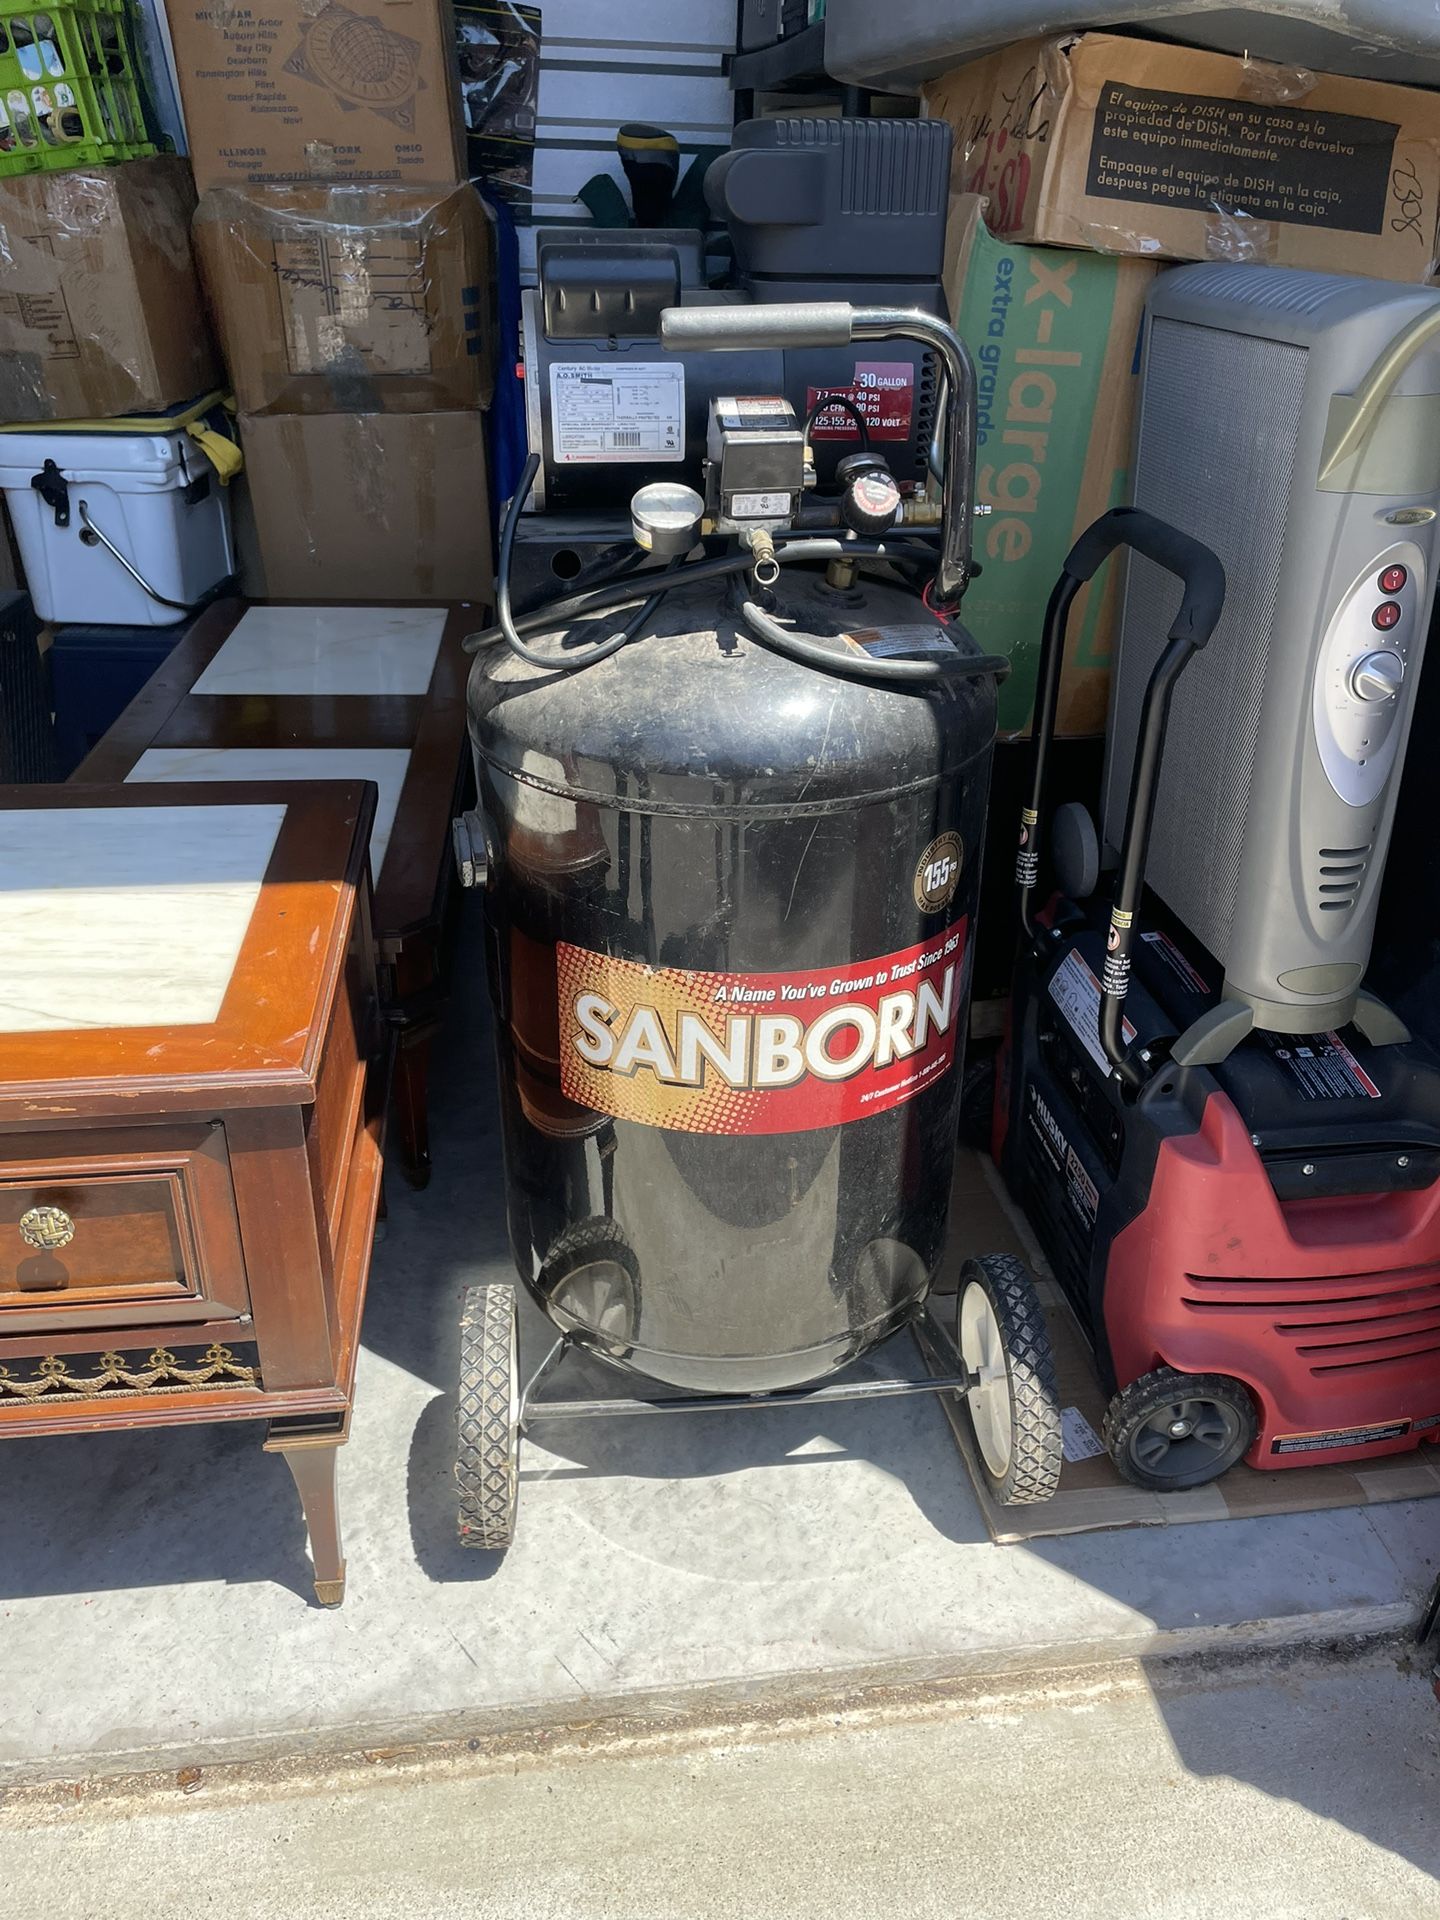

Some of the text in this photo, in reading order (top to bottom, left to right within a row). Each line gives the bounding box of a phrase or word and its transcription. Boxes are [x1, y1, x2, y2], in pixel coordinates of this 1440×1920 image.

[1105, 111, 1354, 156] propiedad de DISH. Por favor devuelva
[1109, 91, 1326, 135] El equipo de DISH en su casa es la
[1103, 125, 1280, 162] este equipo inmediatamente.
[1097, 171, 1329, 217] despues pegue la etiqueta en la caja.
[1099, 155, 1342, 204] Empaque el equipo de DISH en la caja,
[975, 257, 1015, 447] extra grande
[856, 392, 867, 401] 40
[868, 393, 881, 402] PSI
[860, 373, 908, 388] 30 GALLON
[815, 417, 901, 427] 125-155 PS 120 VOLT
[830, 404, 845, 412] CFM
[867, 404, 880, 413] PSI
[977, 254, 1083, 563] x-large
[917, 835, 949, 877] INDUSTRY
[924, 856, 950, 892] 155
[715, 933, 961, 1002] A Name You've Grown to Trust Since 1963
[571, 962, 956, 1090] SANBORN
[1036, 1094, 1068, 1154] HUSKY
